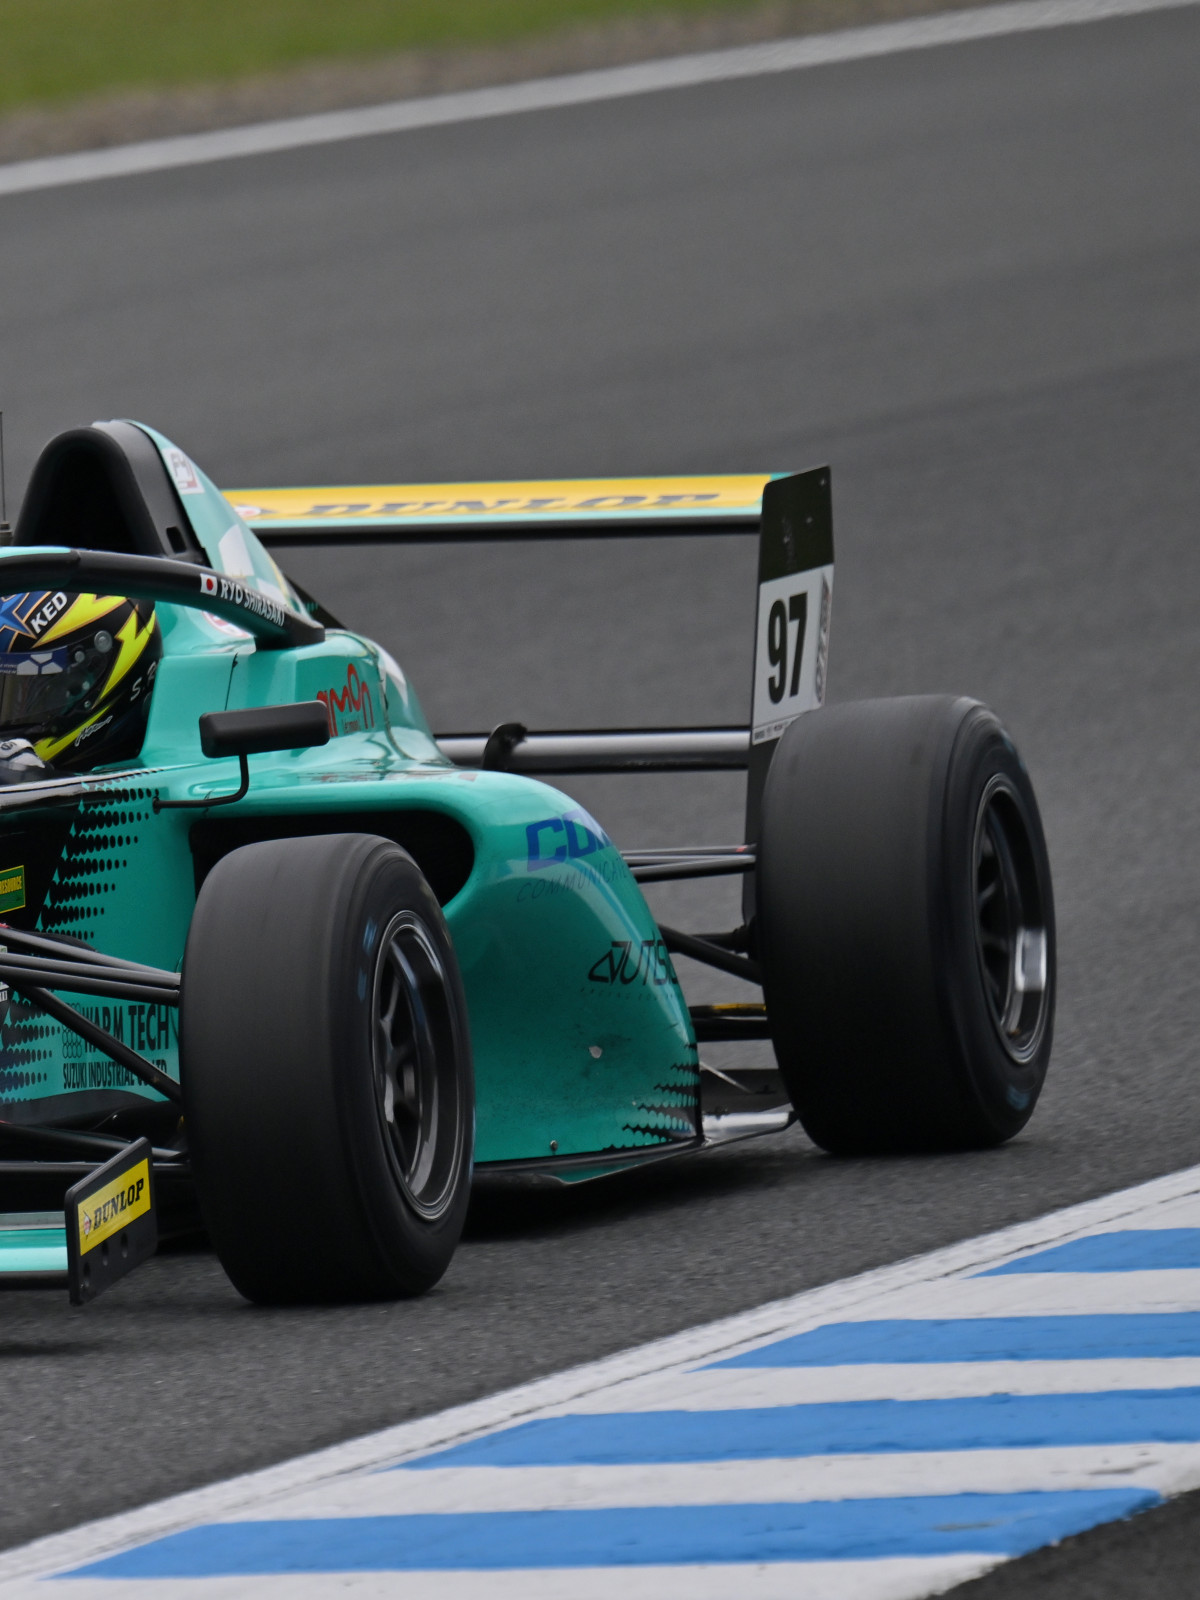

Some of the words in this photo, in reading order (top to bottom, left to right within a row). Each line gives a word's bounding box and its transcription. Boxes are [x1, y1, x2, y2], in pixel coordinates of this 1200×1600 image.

[306, 493, 721, 517] DUNLOP
[30, 591, 68, 634] KED
[220, 578, 243, 604] RYO
[243, 588, 285, 627] SHIRASAKI
[767, 592, 808, 704] 97
[128, 1003, 169, 1051] TECH
[63, 1063, 87, 1089] SUZUKI
[93, 1177, 145, 1232] DUNLOP
